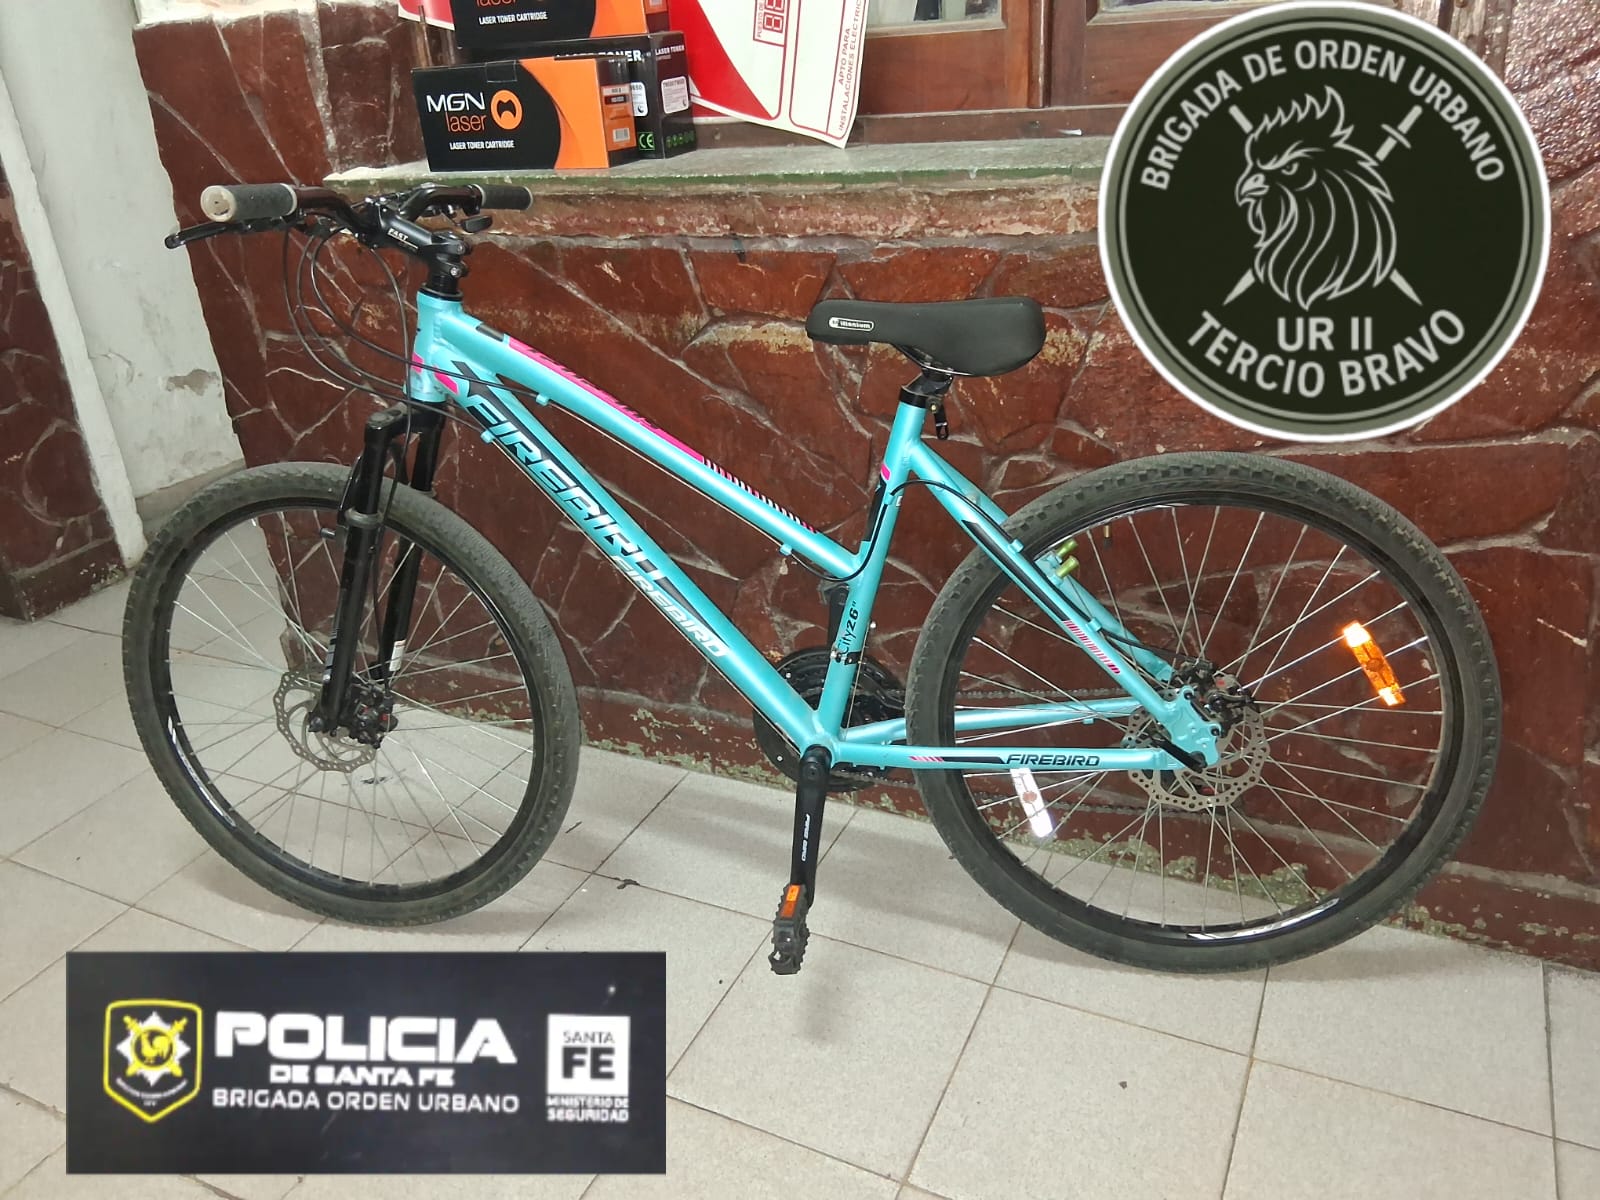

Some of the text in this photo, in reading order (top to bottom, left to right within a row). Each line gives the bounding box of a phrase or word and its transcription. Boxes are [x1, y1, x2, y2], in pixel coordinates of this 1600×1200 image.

[838, 28, 851, 85] APTO PARA
[426, 92, 486, 112] MGN
[838, 53, 855, 131] INSTALACIONES
[445, 111, 486, 132] laser
[606, 555, 730, 658] FIREBIRD
[1005, 754, 1100, 767] FIREBIRD
